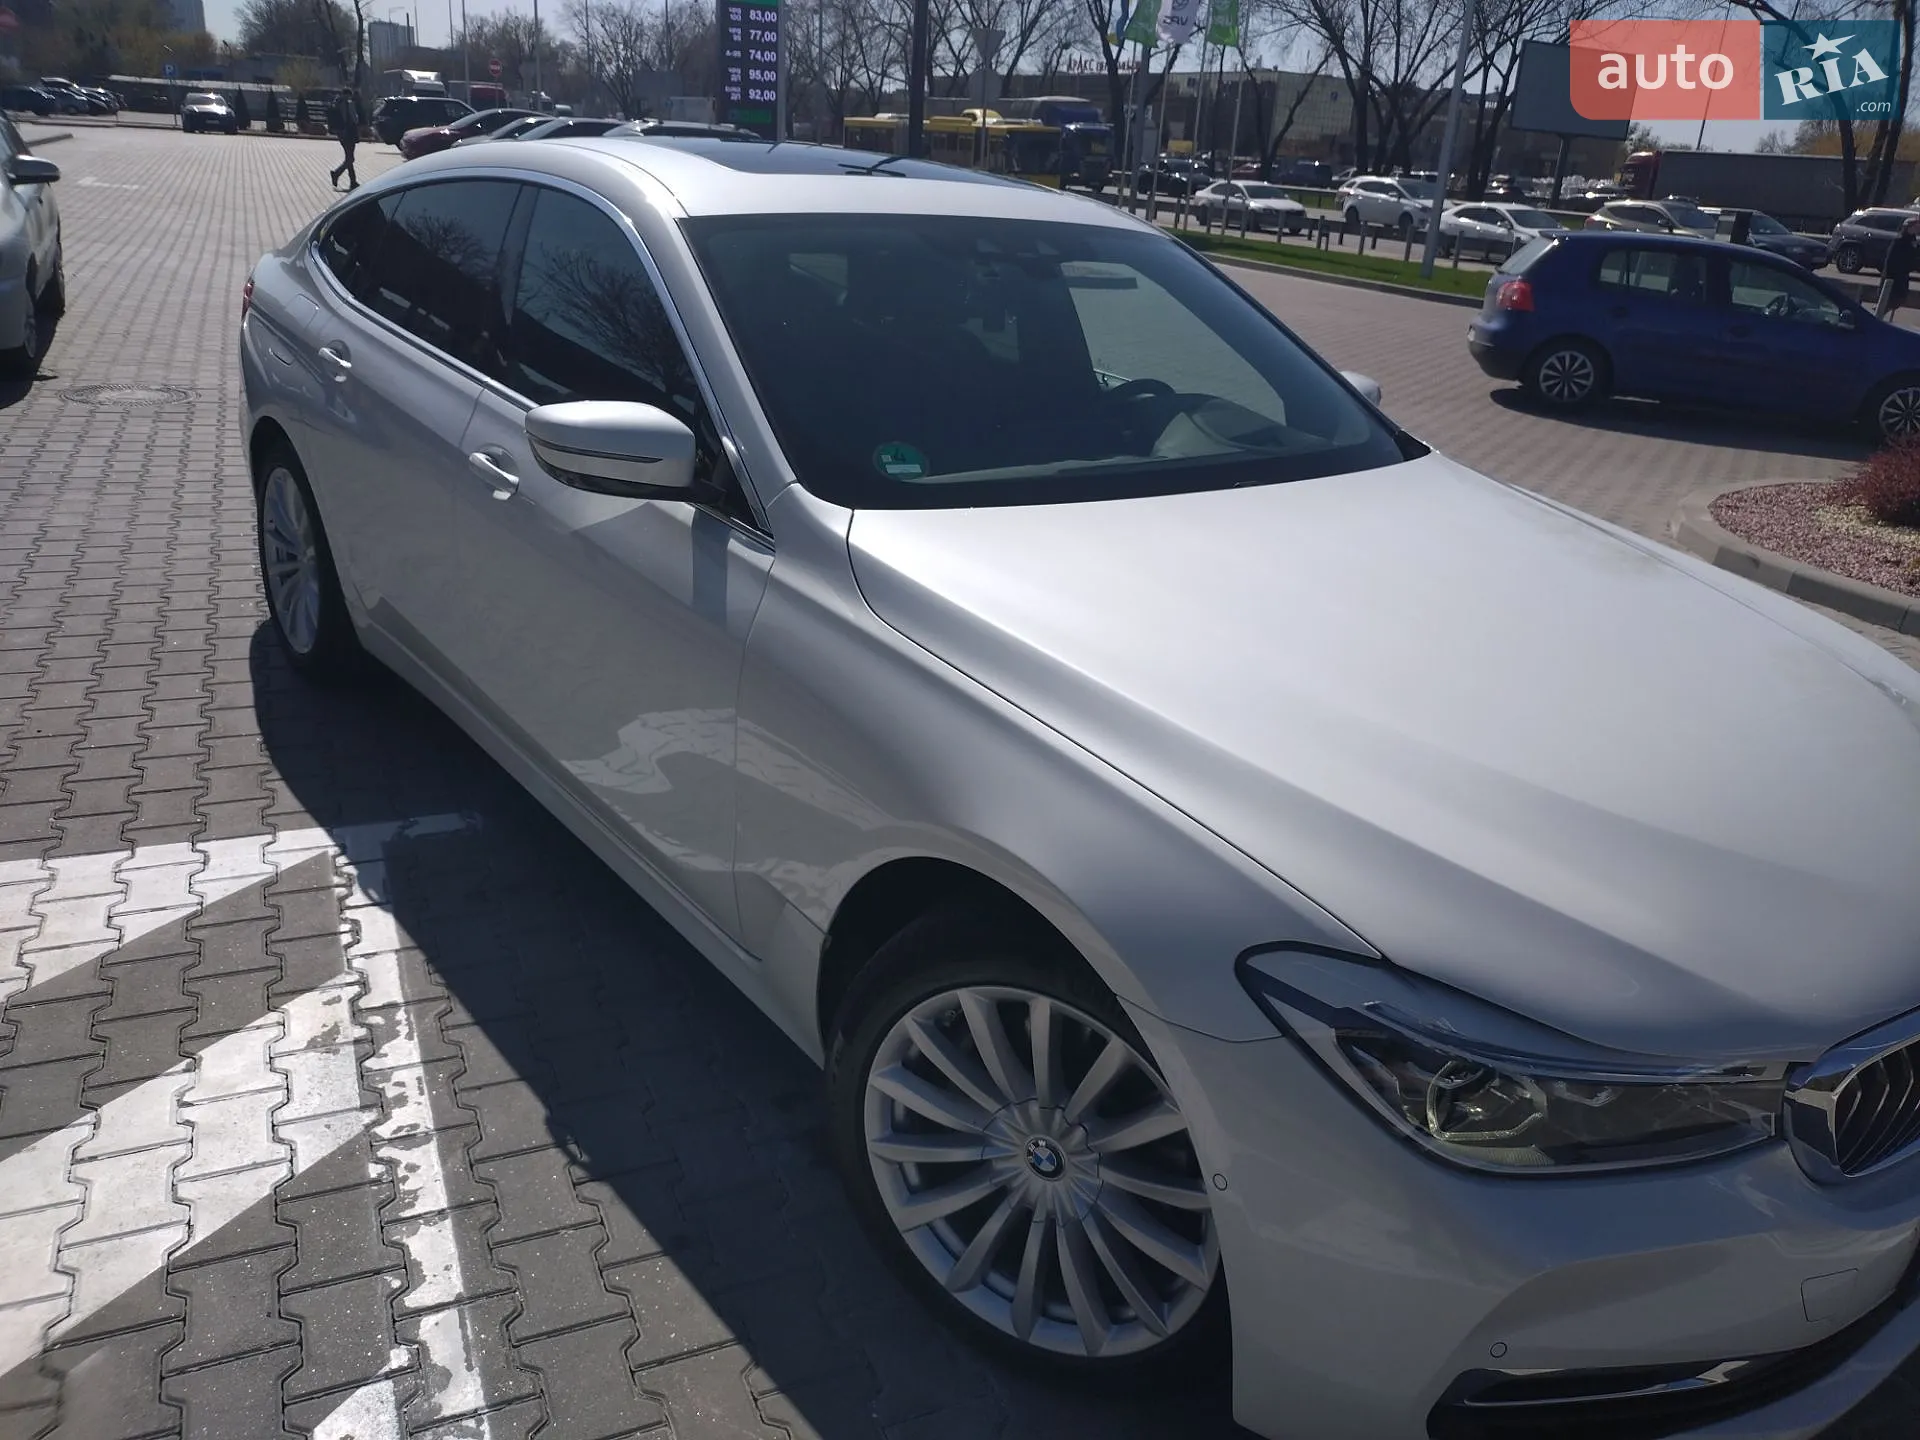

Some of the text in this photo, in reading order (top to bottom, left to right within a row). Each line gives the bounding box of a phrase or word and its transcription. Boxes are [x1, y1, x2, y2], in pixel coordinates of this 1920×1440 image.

[749, 9, 777, 23] 83,00
[749, 29, 777, 43] 77,00
[748, 49, 777, 62] 74,00
[748, 69, 777, 83] 95,00
[748, 89, 777, 102] 92,00
